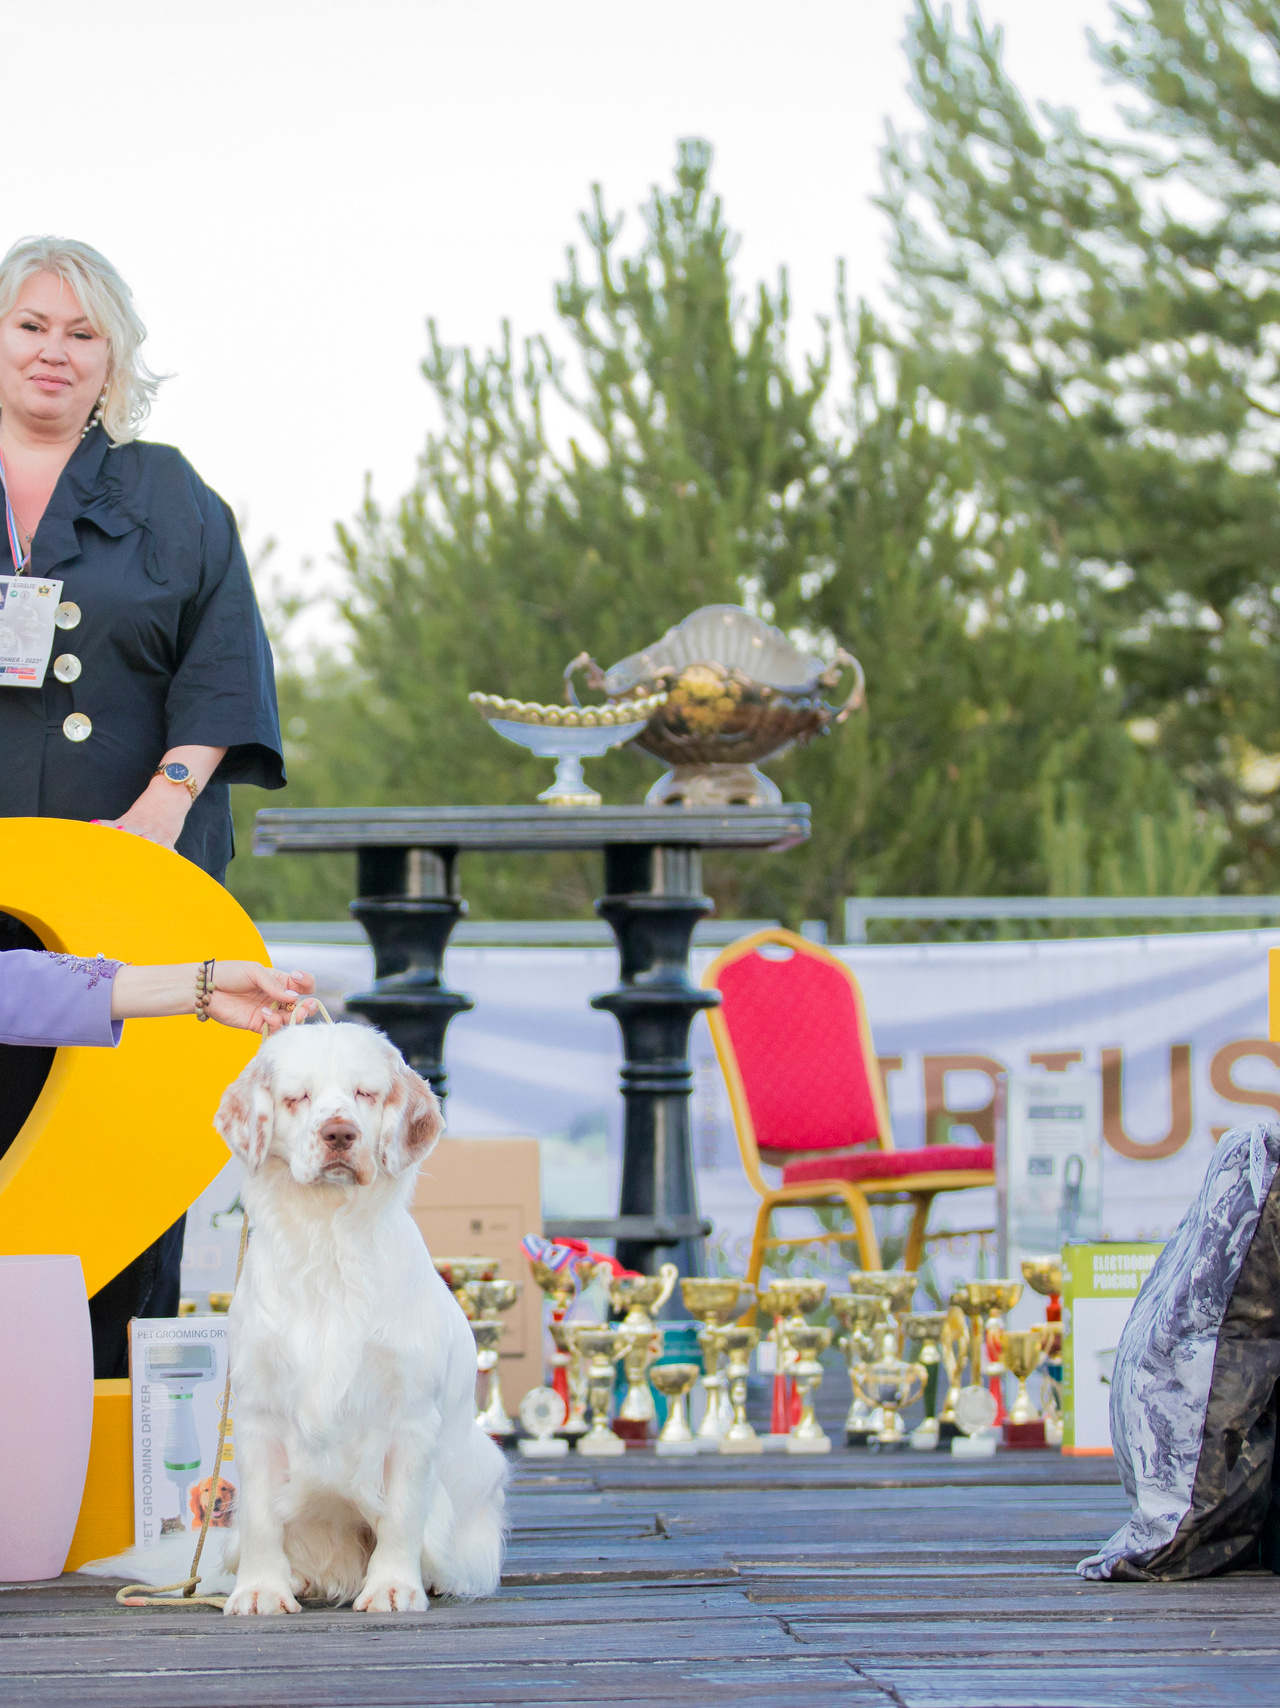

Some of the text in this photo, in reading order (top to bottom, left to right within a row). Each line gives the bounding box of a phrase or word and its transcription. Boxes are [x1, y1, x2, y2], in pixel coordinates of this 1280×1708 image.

[137, 1330, 154, 1339] PET
[155, 1329, 208, 1338] GROOMING
[141, 1384, 153, 1546] PET GROOMING DRYER
